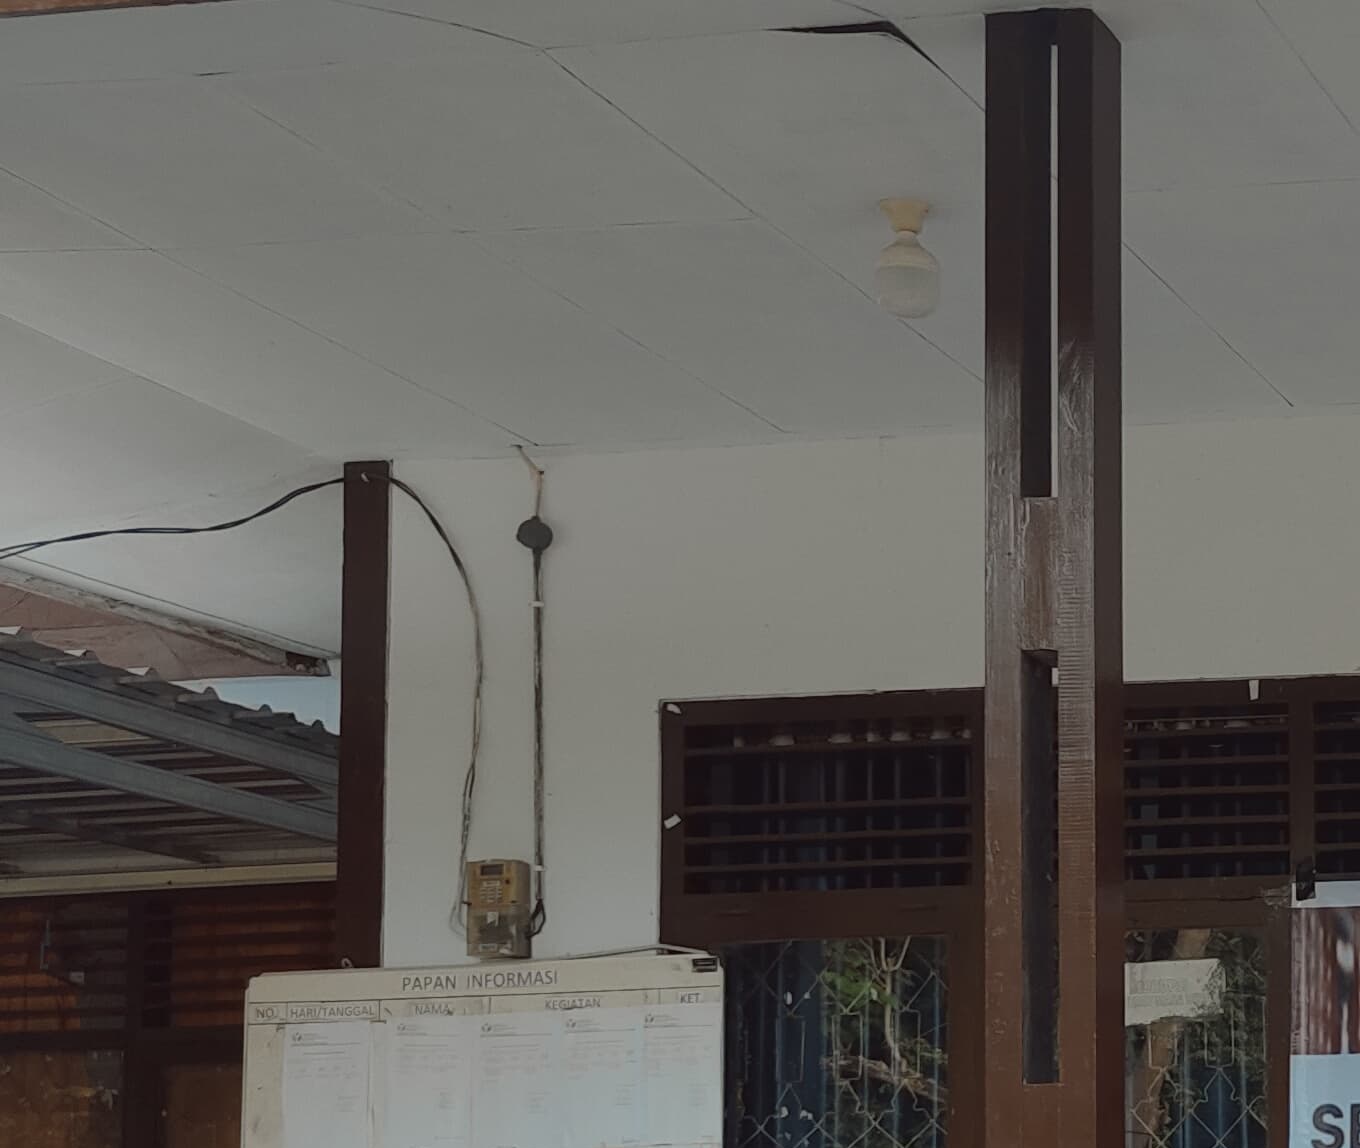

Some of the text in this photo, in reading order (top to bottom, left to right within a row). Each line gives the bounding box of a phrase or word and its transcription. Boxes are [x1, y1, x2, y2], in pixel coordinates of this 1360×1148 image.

[402, 970, 558, 992] PAPAN INFORMASI
[289, 1005, 375, 1018] HARI/TANGGAL
[544, 998, 601, 1010] KEGIATAN
